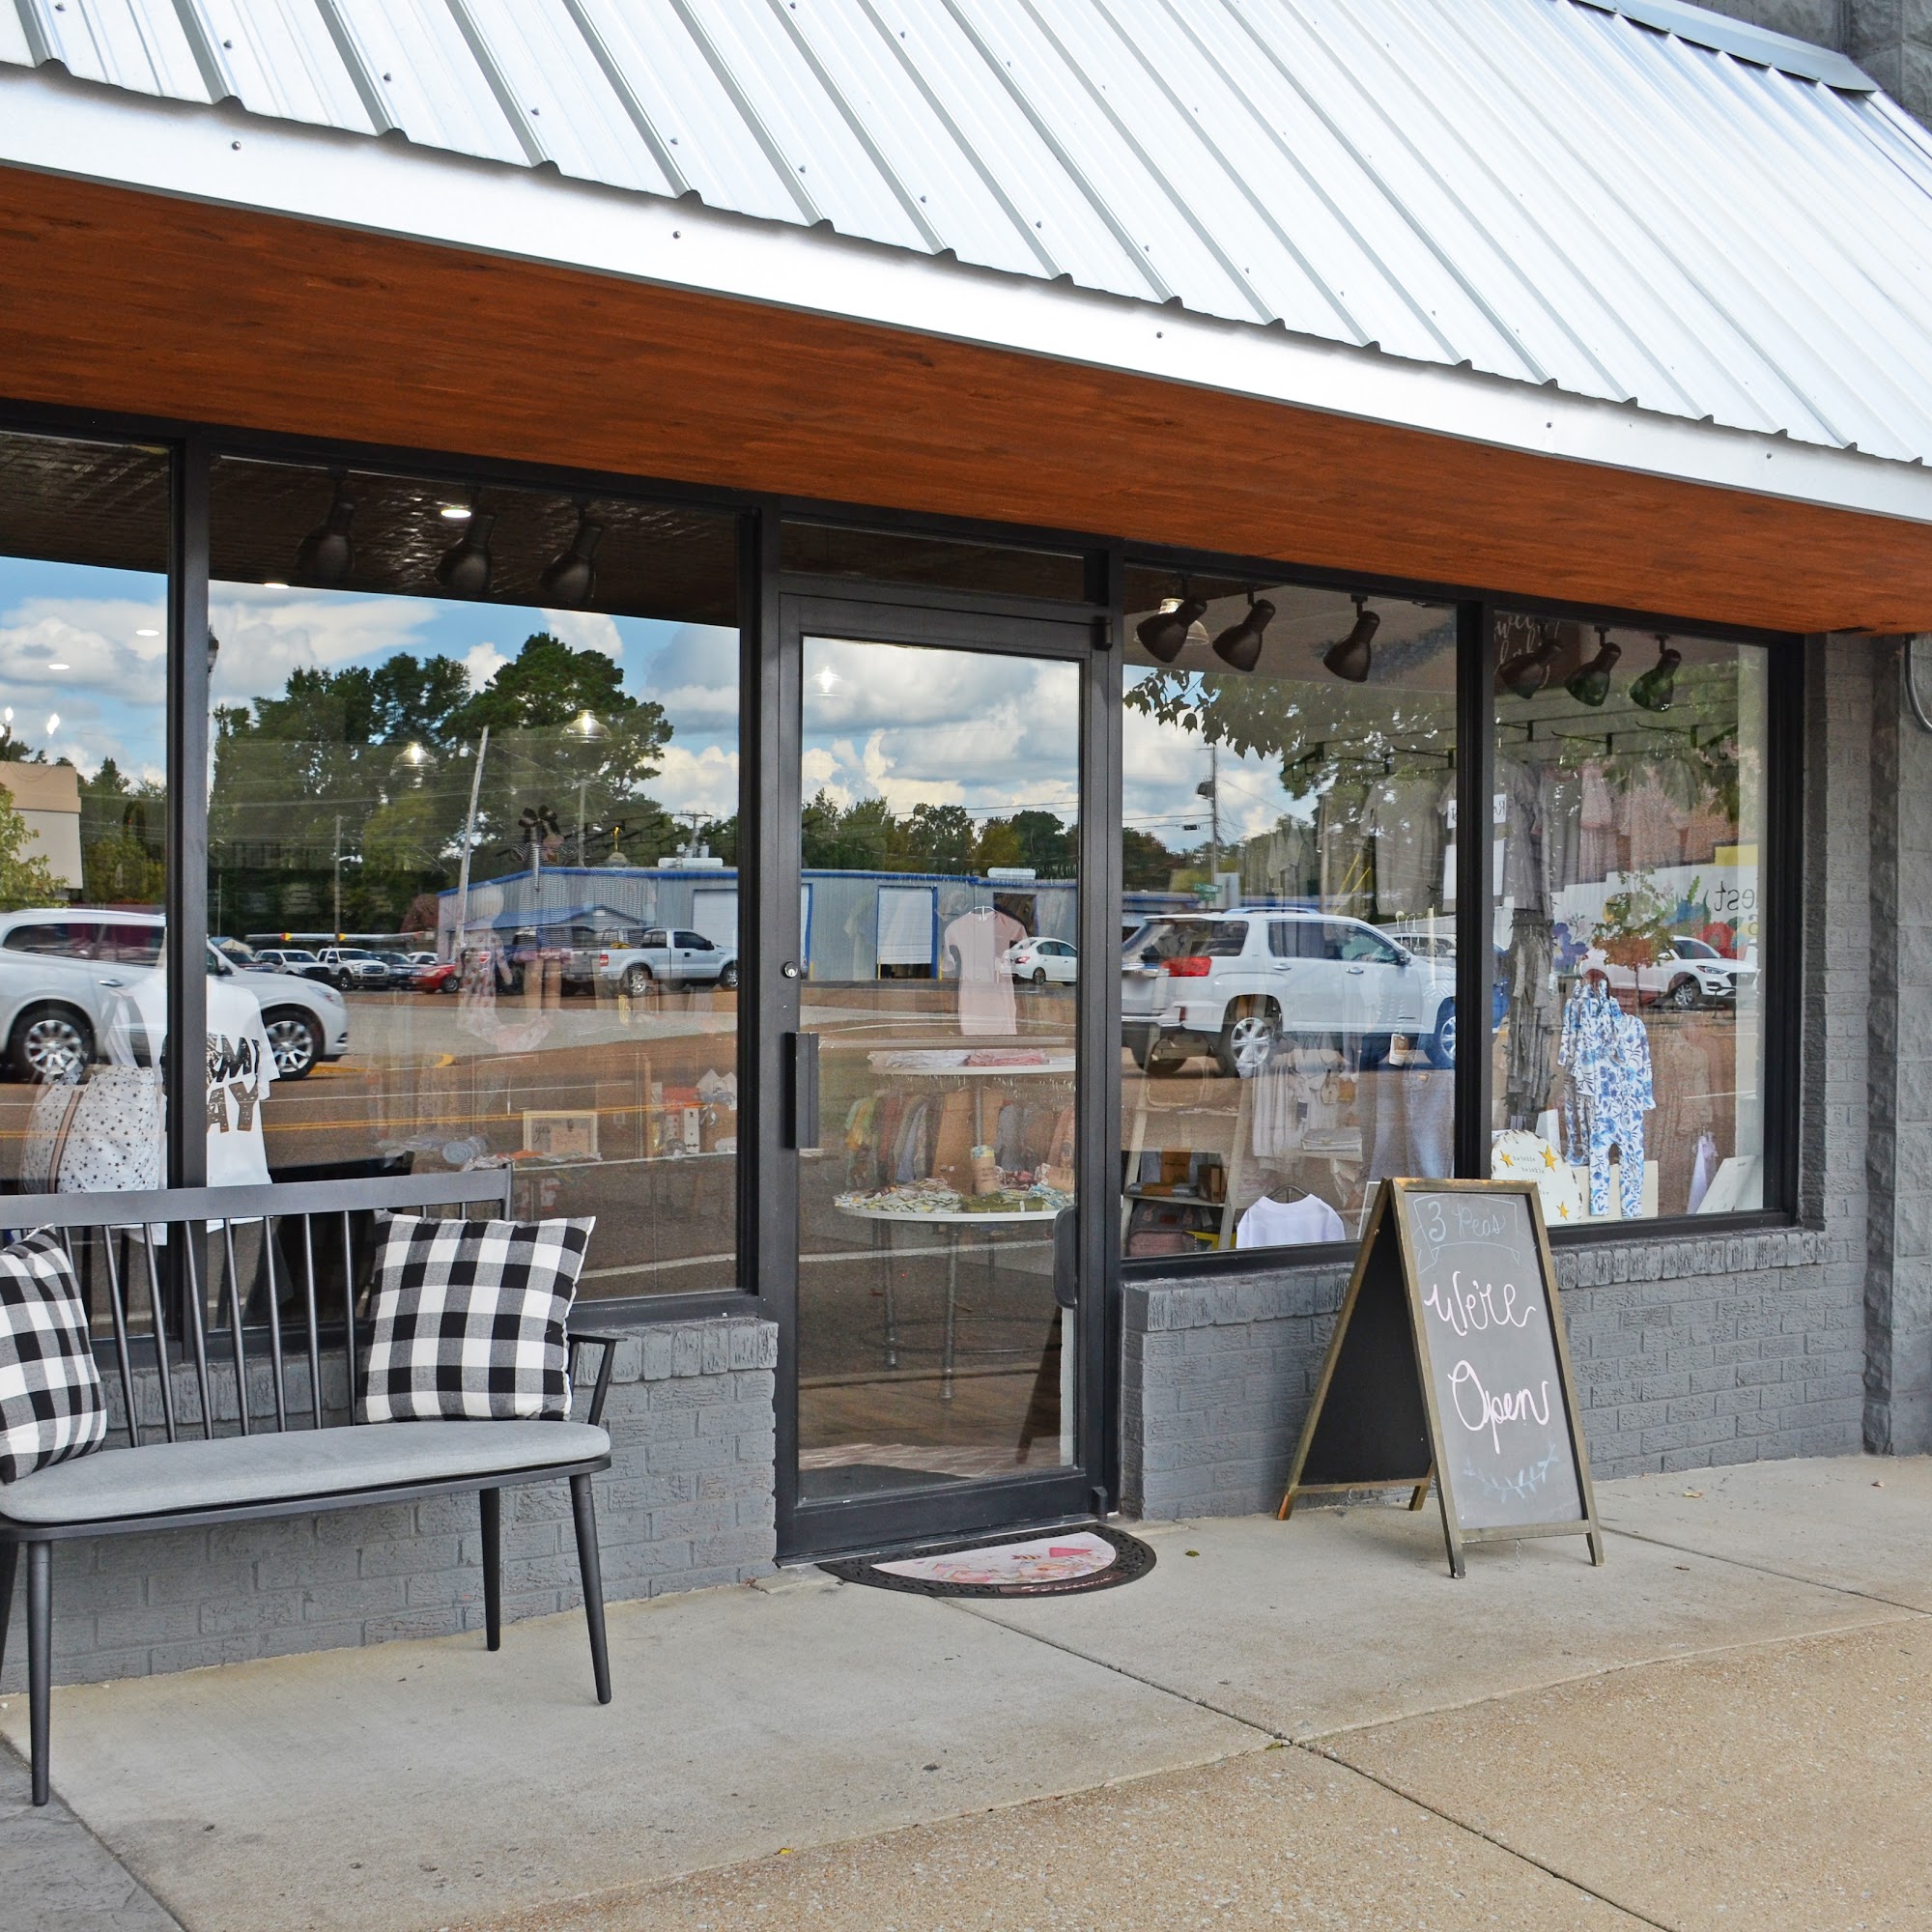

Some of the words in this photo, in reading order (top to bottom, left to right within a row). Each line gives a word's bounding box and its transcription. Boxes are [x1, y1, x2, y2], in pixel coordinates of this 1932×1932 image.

[1428, 1201, 1446, 1242] 3
[1424, 1270, 1536, 1337] We're
[1447, 1359, 1549, 1454] Open
